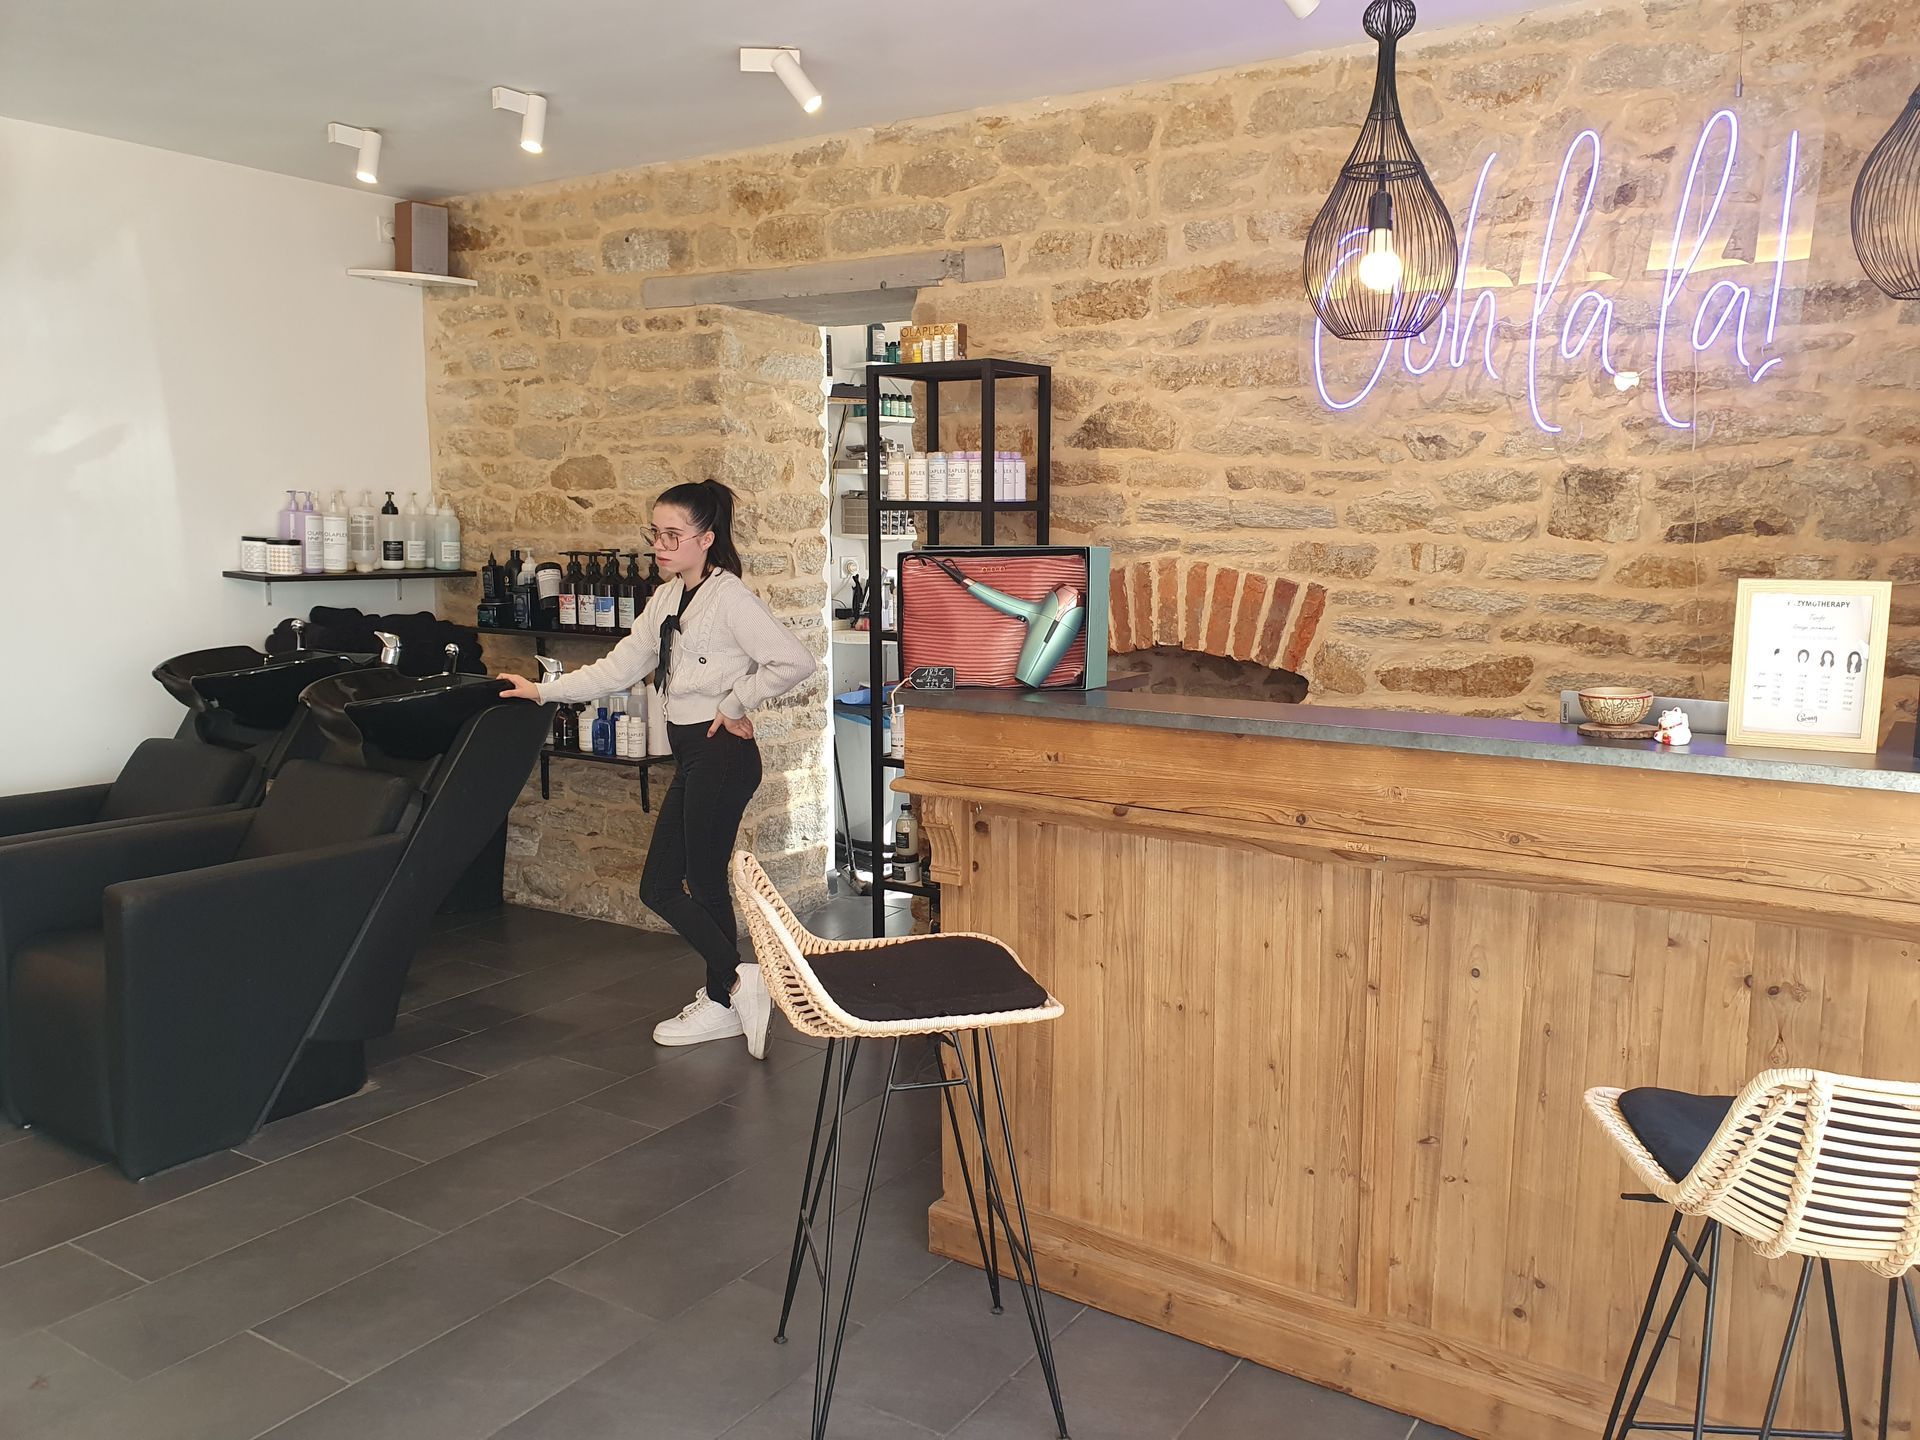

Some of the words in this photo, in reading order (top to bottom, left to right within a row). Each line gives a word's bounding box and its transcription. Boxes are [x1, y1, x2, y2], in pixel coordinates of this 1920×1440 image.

[1313, 151, 1500, 411] Ooh
[1528, 129, 1617, 434] la
[1656, 109, 1800, 430] la!
[900, 325, 946, 338] OLAPLEX
[1787, 599, 1851, 608] ZYMOTHERAPY
